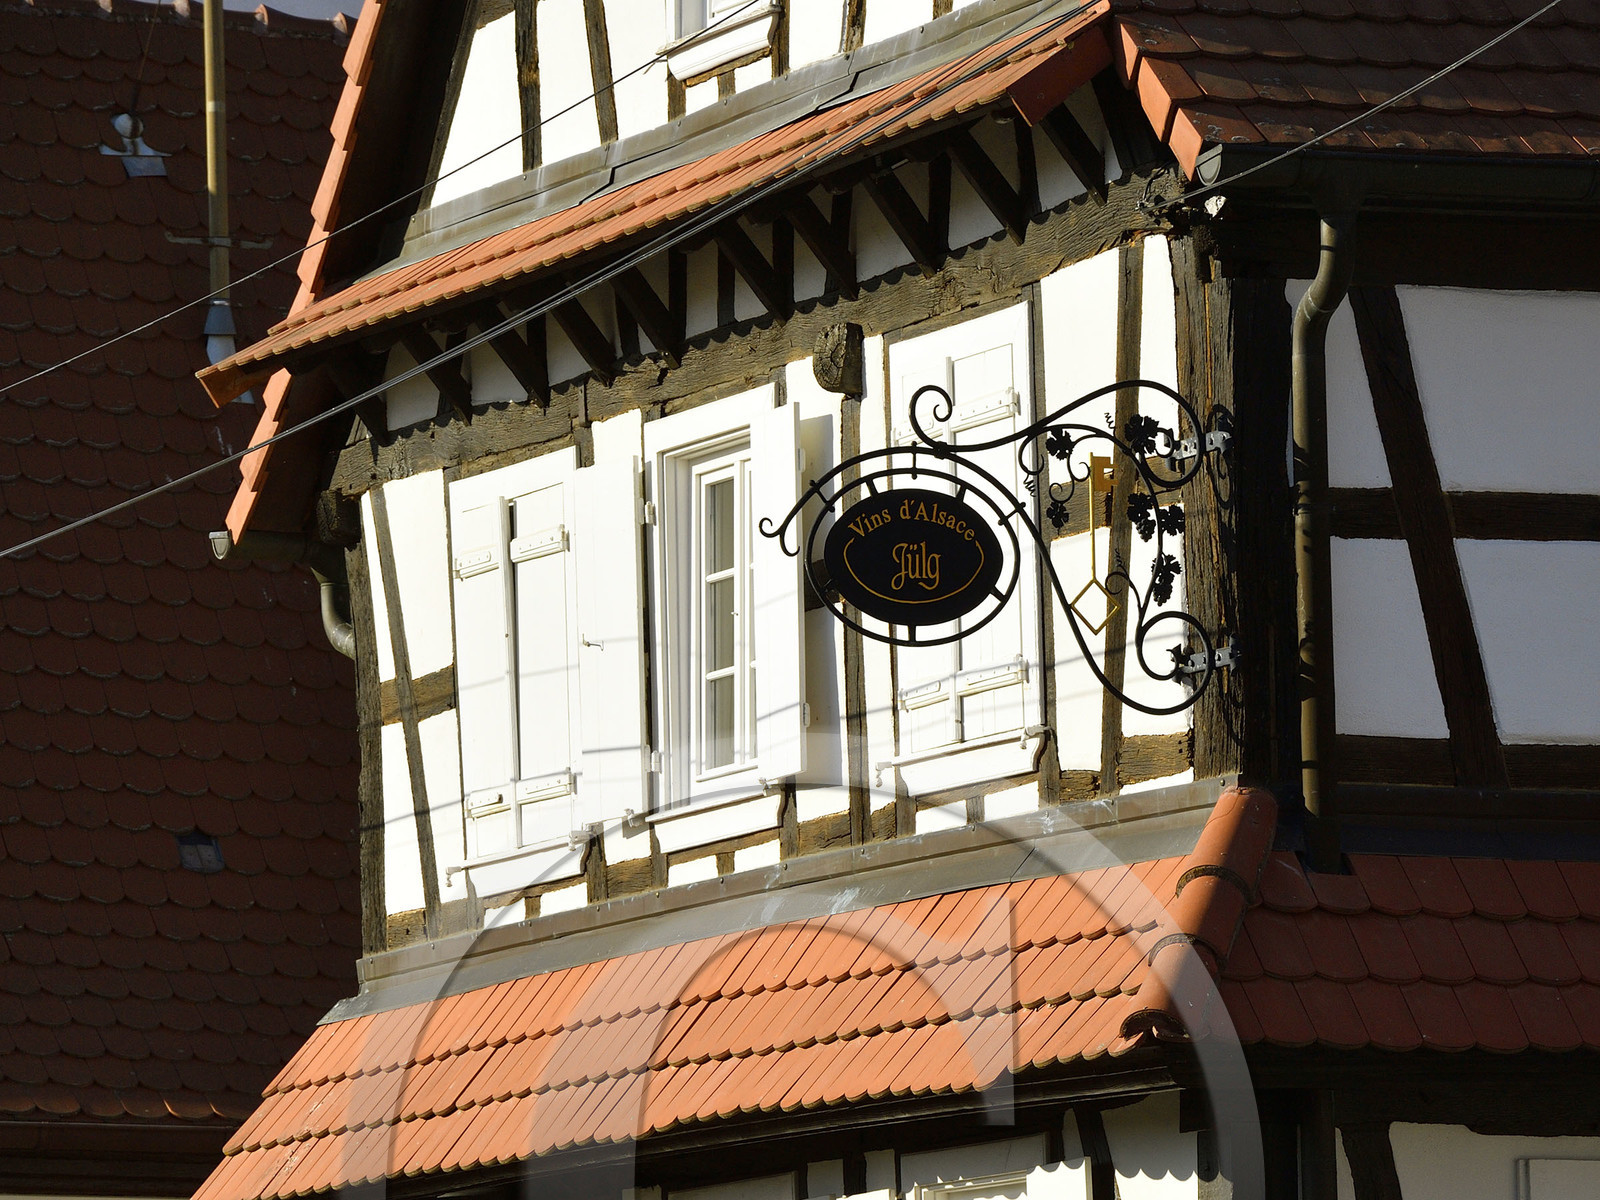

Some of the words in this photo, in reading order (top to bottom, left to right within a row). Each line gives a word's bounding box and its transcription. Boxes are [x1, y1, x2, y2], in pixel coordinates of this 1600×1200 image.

[848, 508, 892, 537] Vins
[900, 498, 975, 541] d'Alsace
[891, 540, 941, 591] Jülg
